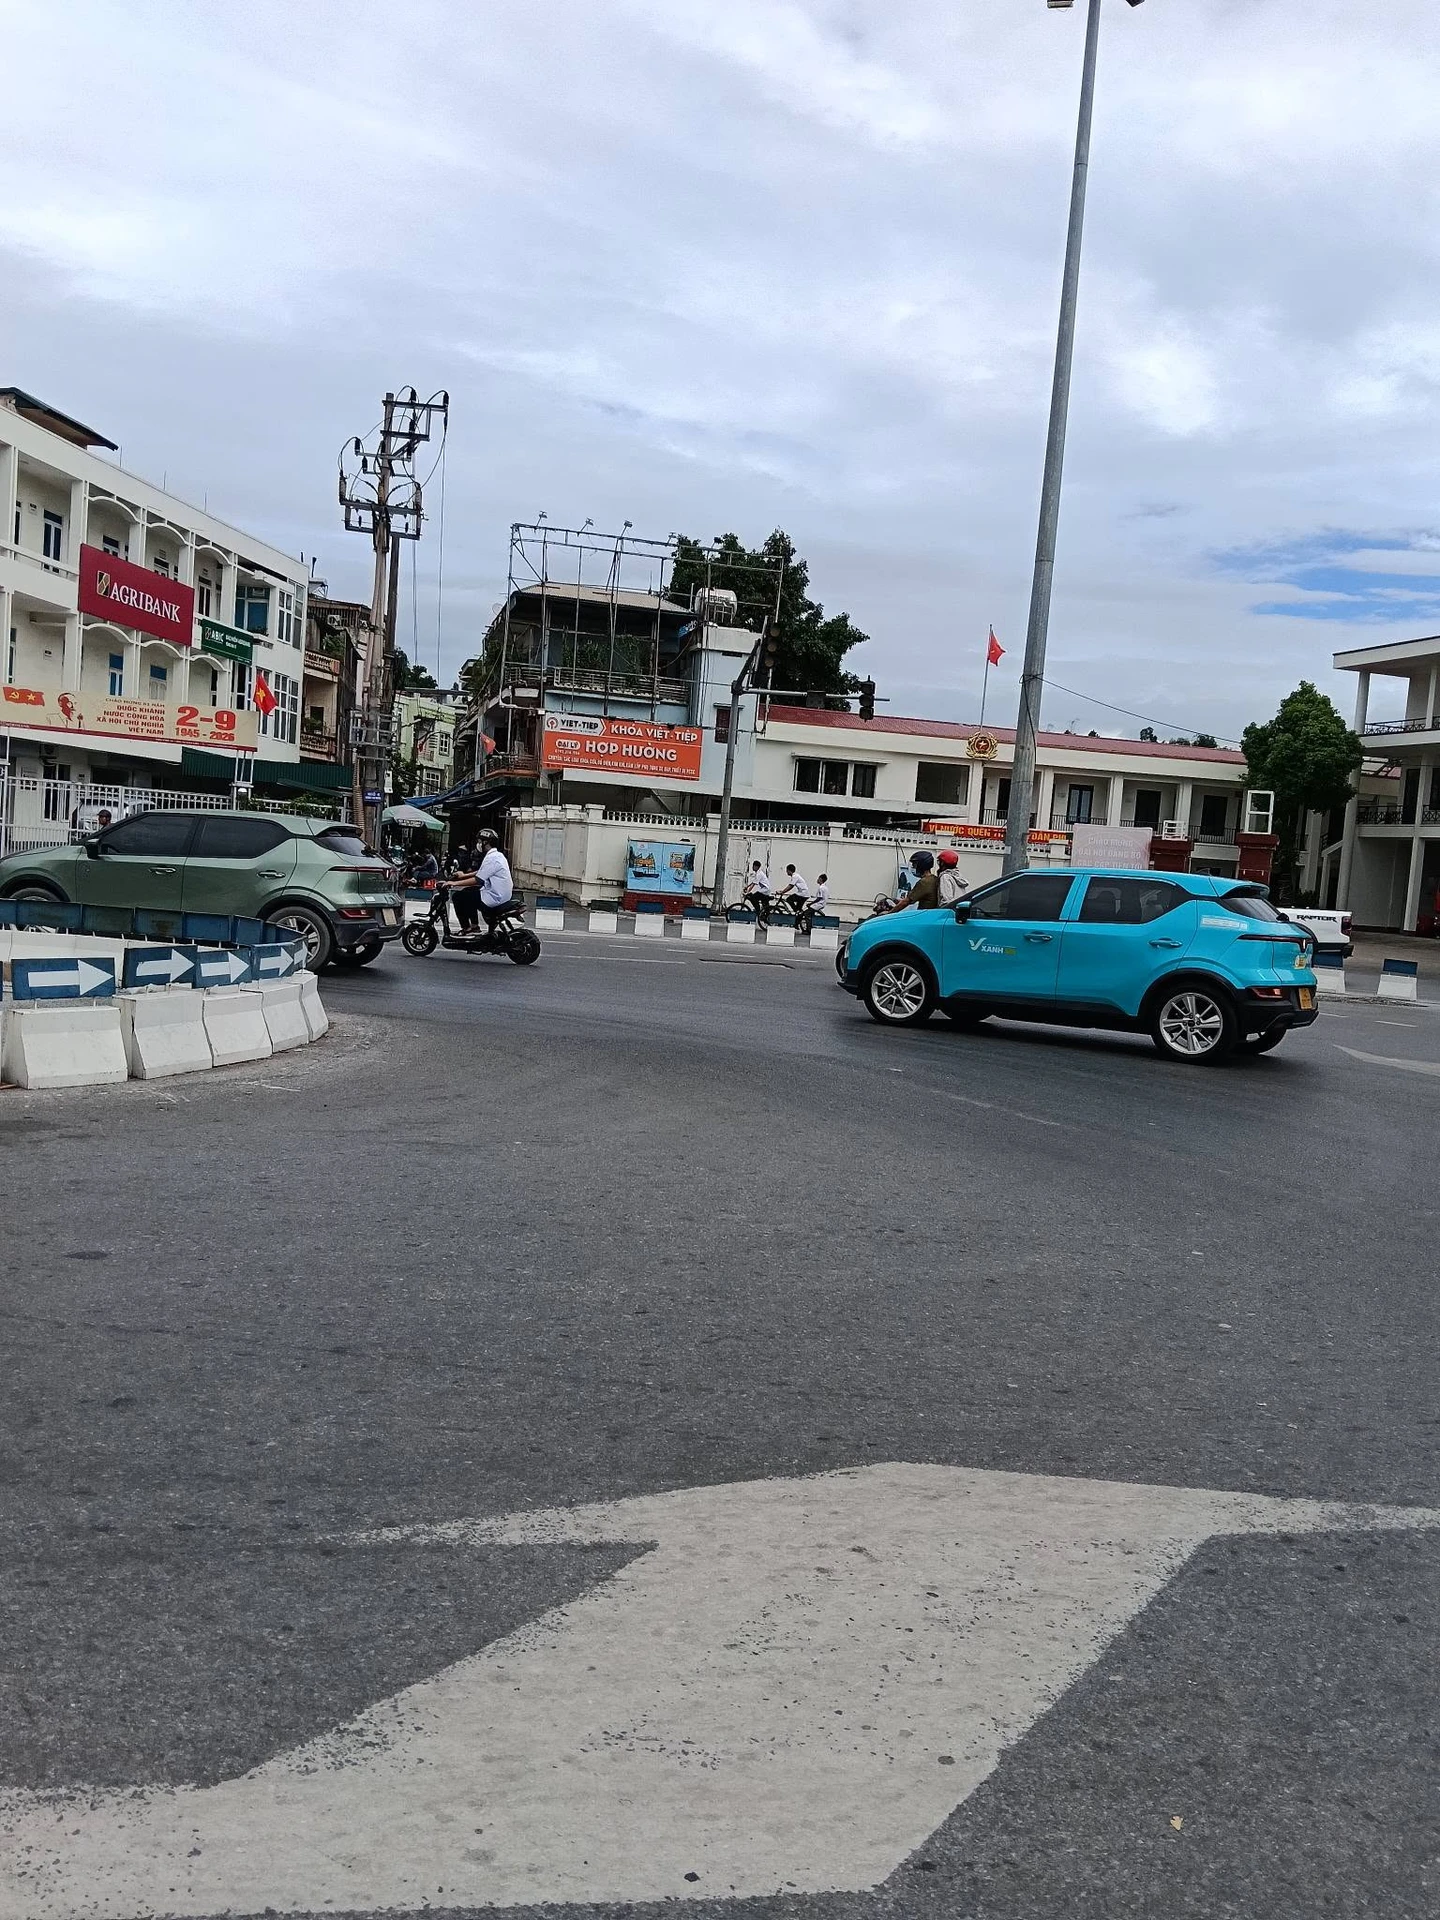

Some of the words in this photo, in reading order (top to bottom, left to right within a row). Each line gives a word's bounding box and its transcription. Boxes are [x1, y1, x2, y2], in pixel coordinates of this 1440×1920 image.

[110, 582, 181, 623] AGRIBANK
[103, 710, 125, 718] NƯỚC
[126, 712, 148, 720] CỘNG
[117, 704, 137, 712] QUỐC
[139, 706, 165, 715] KHÁNH
[176, 706, 236, 731] 2-9
[146, 728, 164, 736] NAM
[175, 727, 200, 738] 1945
[611, 723, 643, 737] KHÓA
[585, 740, 619, 757] HỢP
[622, 742, 677, 761] HƯỜNG
[1296, 914, 1338, 923] RAPTOR
[981, 945, 1004, 954] XANH
